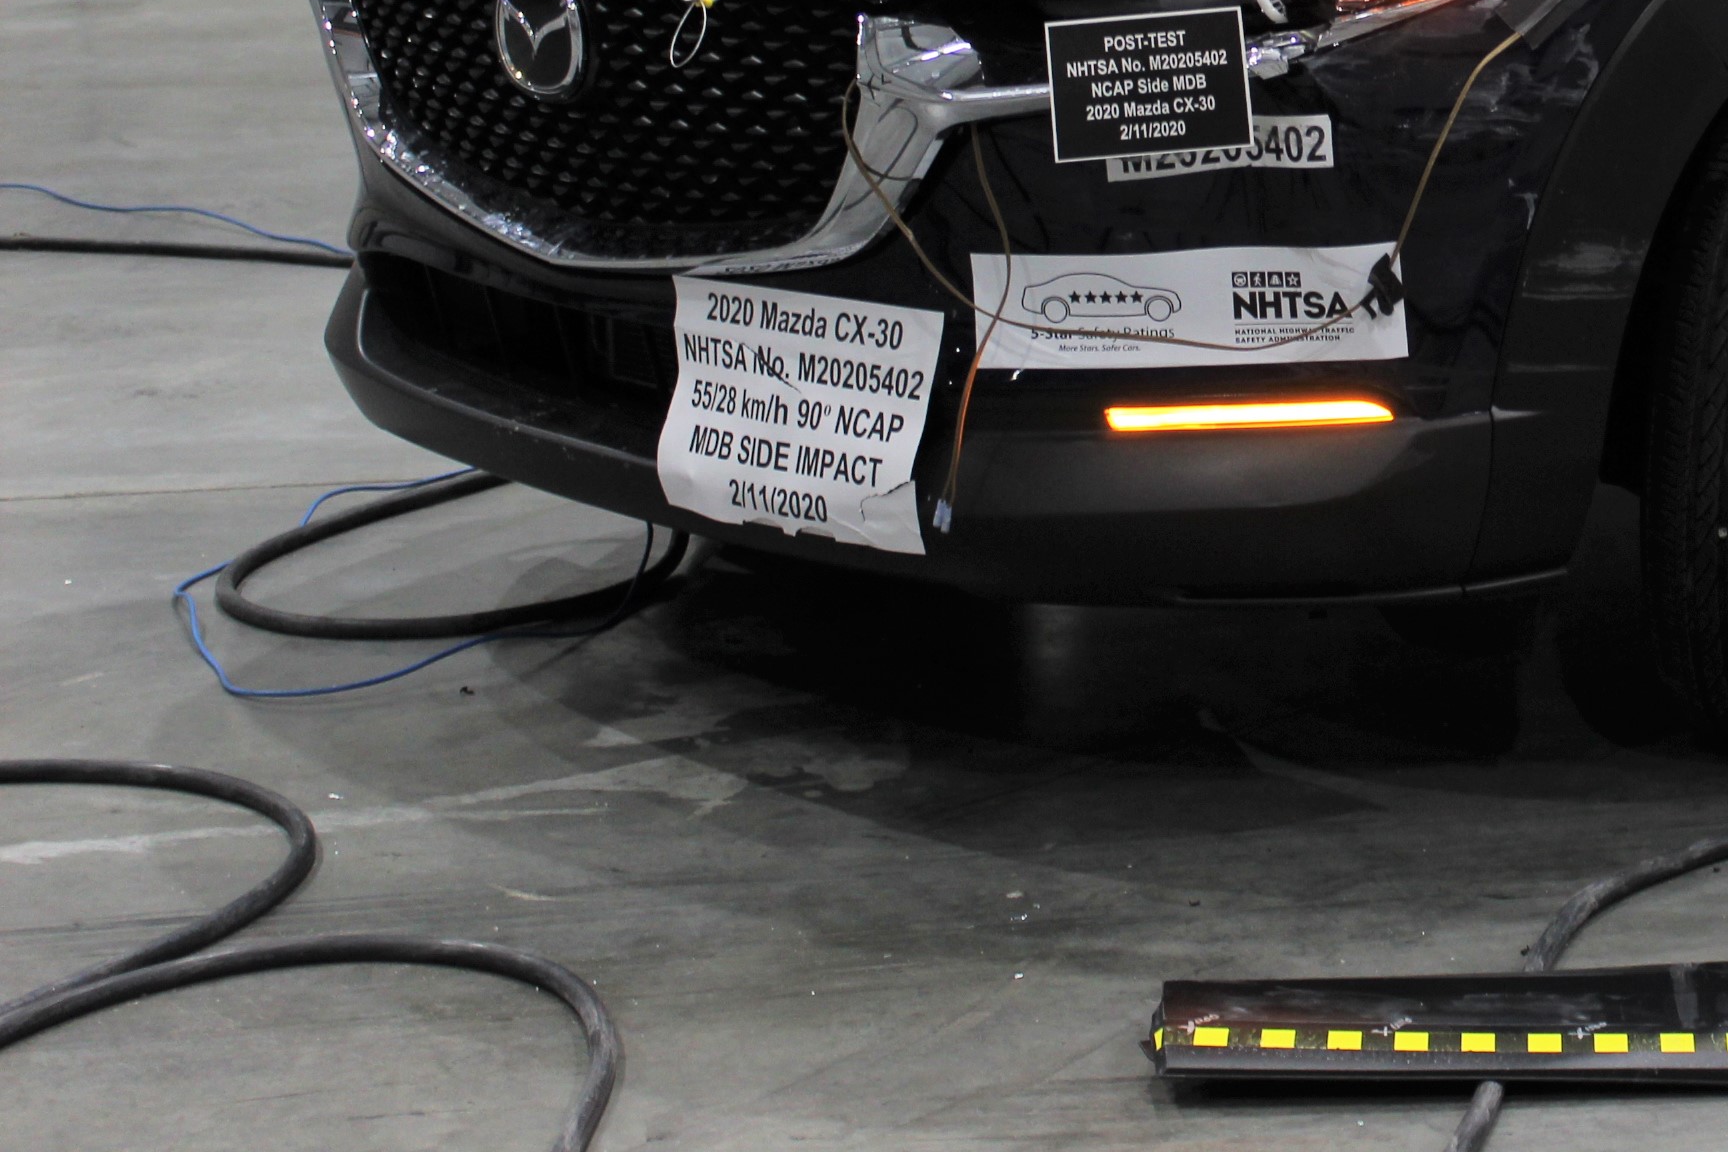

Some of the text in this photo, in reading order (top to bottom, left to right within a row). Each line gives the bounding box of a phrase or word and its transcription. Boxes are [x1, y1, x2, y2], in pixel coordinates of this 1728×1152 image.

[1104, 29, 1186, 52] POST-TEST
[1066, 49, 1227, 78] NHTSA No. M20205402
[1091, 73, 1207, 98] NCAP Side MDB
[1086, 94, 1216, 121] 2020 Mazda CX-30
[1119, 120, 1186, 141] 2/11/2020
[1232, 290, 1353, 320] NHTSA
[706, 292, 904, 350] 2020 Mazda CX-30
[1058, 344, 1141, 352] More Stars. Safer Cars.
[1235, 336, 1266, 344] SAFETY
[684, 333, 925, 401] NHTSA No. M20205402
[691, 379, 736, 415] 55/28
[740, 389, 788, 426] km/h
[834, 404, 905, 443] NCAP
[689, 424, 883, 488] MDB SIDE IMPACT
[728, 479, 829, 524] 2/11/2020
